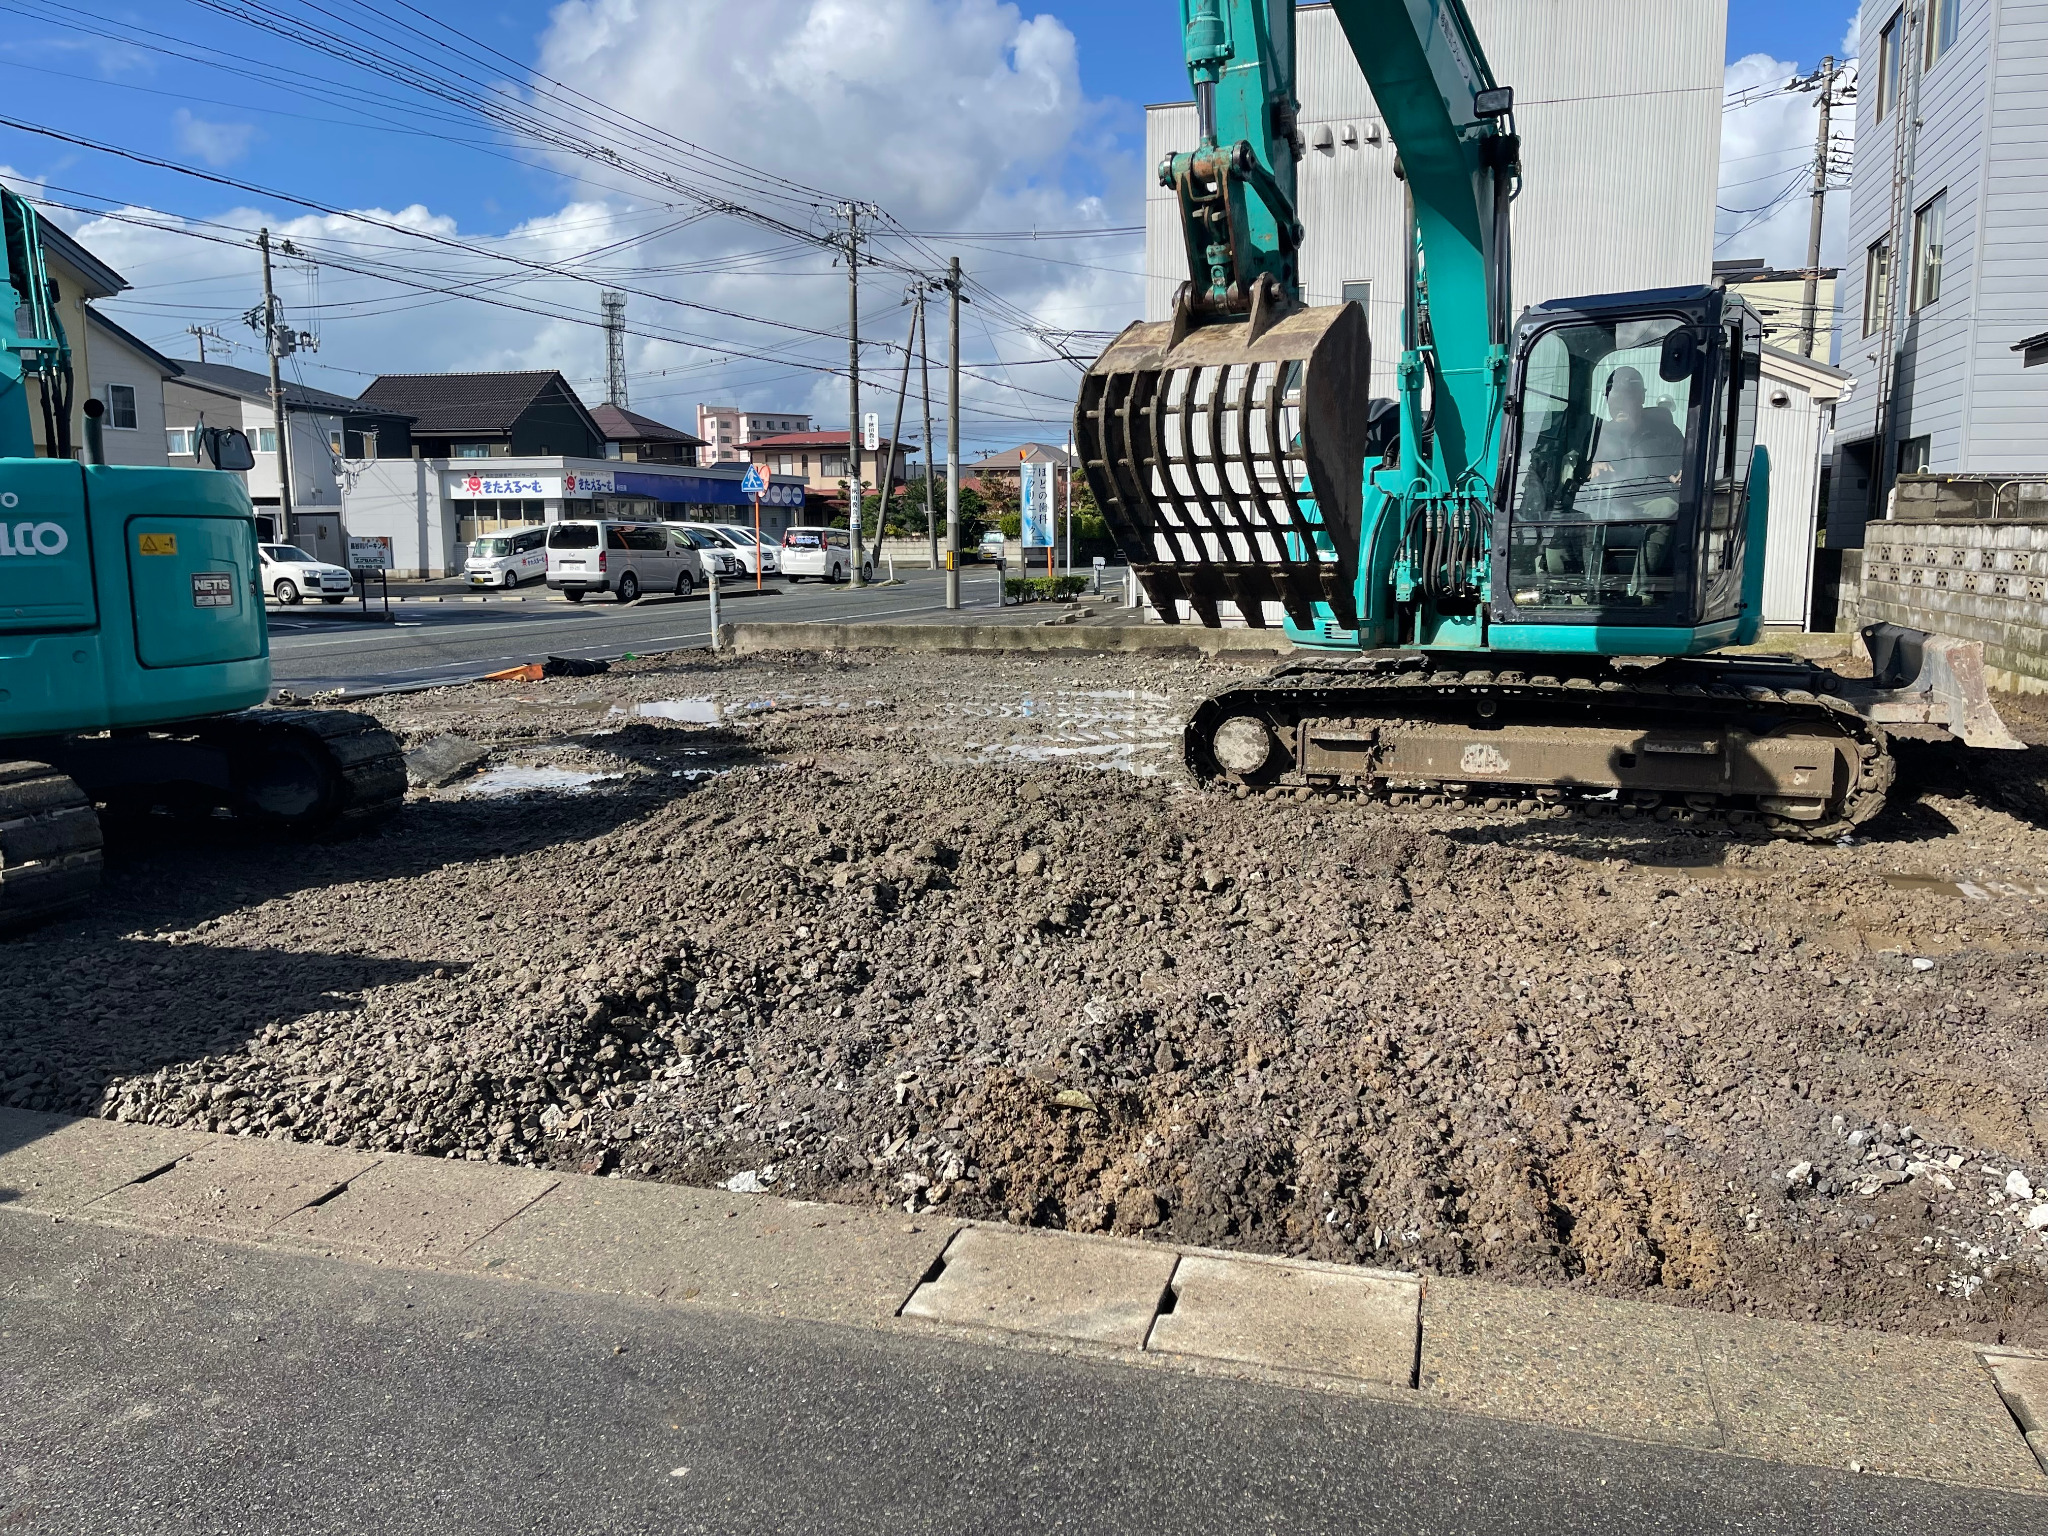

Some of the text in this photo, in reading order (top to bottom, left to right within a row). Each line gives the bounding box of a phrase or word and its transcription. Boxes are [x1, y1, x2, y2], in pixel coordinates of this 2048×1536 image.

[1038, 468, 1048, 524] ほどの歯科
[194, 579, 230, 591] NETIS
